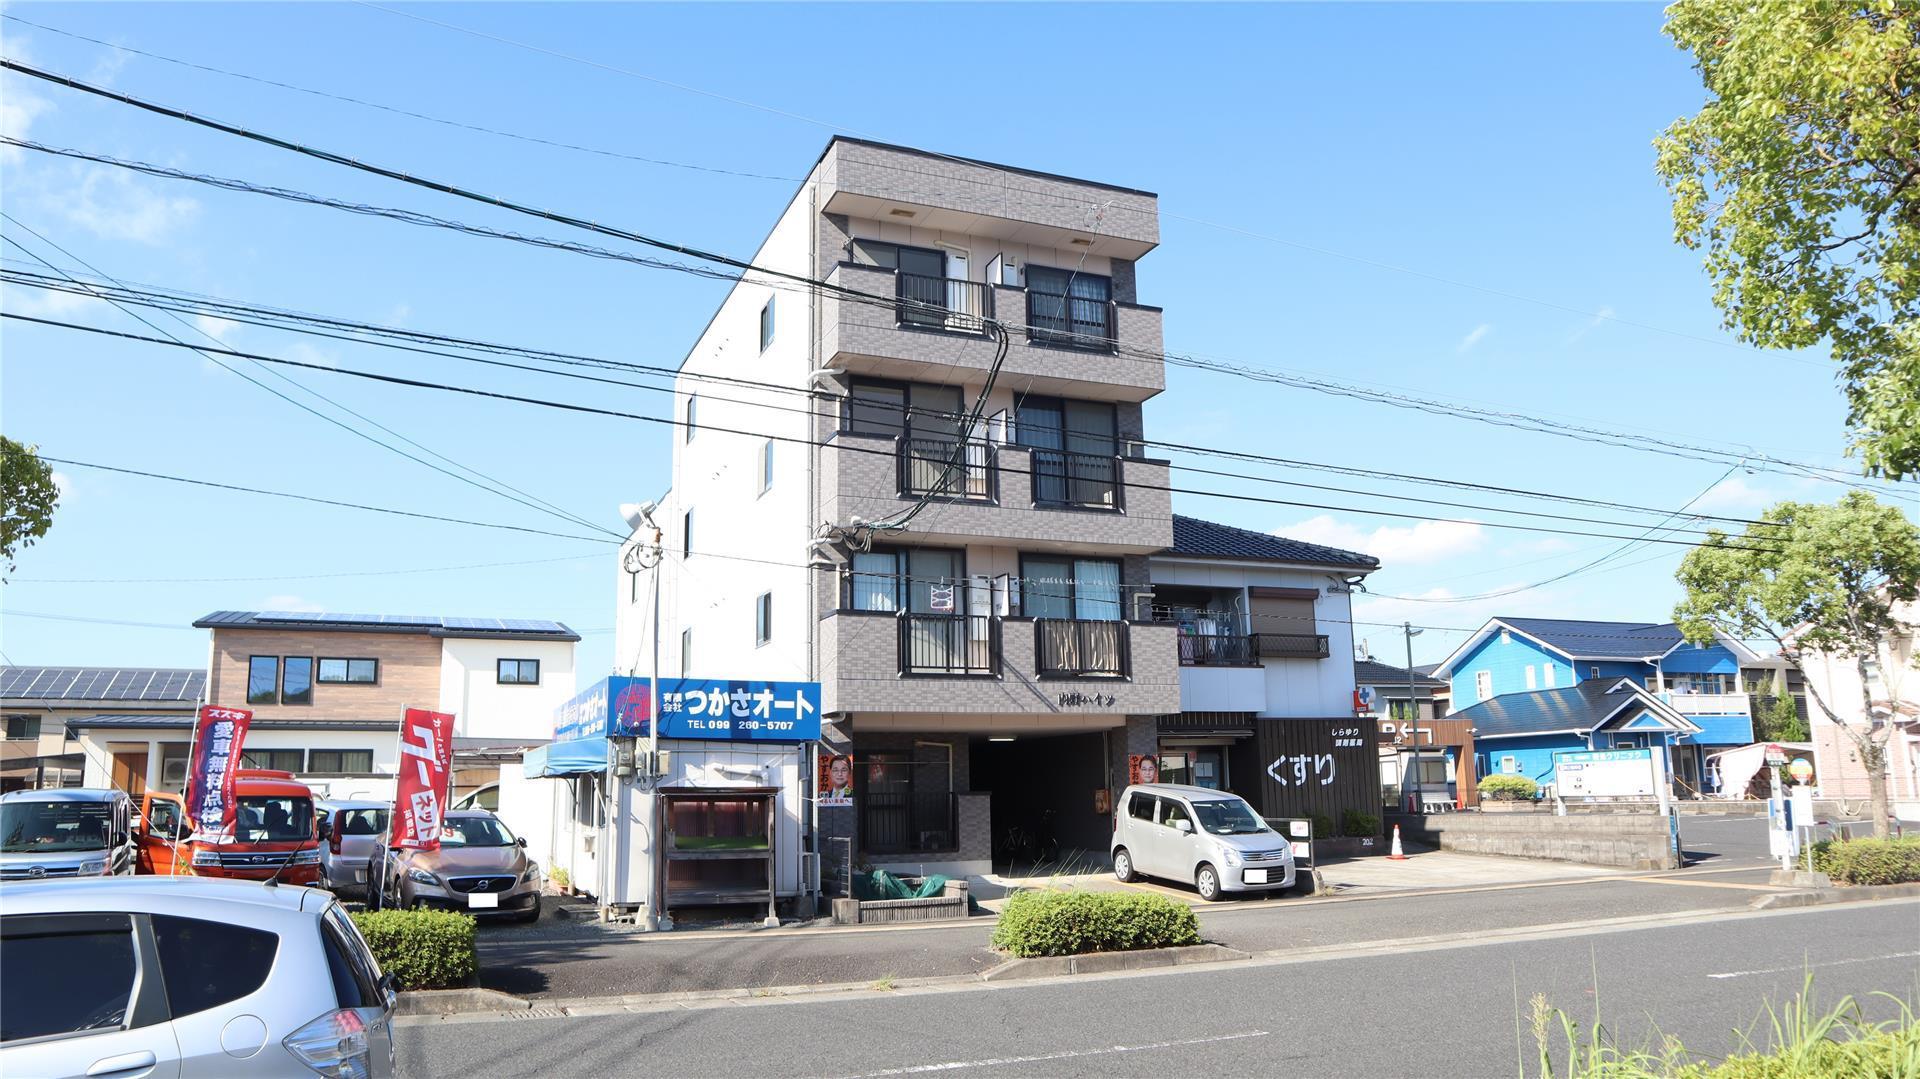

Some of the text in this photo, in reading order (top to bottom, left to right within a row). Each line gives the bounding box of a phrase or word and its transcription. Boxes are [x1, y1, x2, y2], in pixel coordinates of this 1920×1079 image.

[663, 703, 682, 713] 会社
[685, 687, 814, 720] つかさオート
[208, 709, 246, 720] スズキ
[687, 720, 706, 729] TEL
[708, 720, 730, 730] 099
[1331, 728, 1359, 736] しらゆり
[201, 721, 234, 824] 愛車無料点検
[1267, 754, 1336, 786] くすり
[1362, 838, 1374, 846] 202
